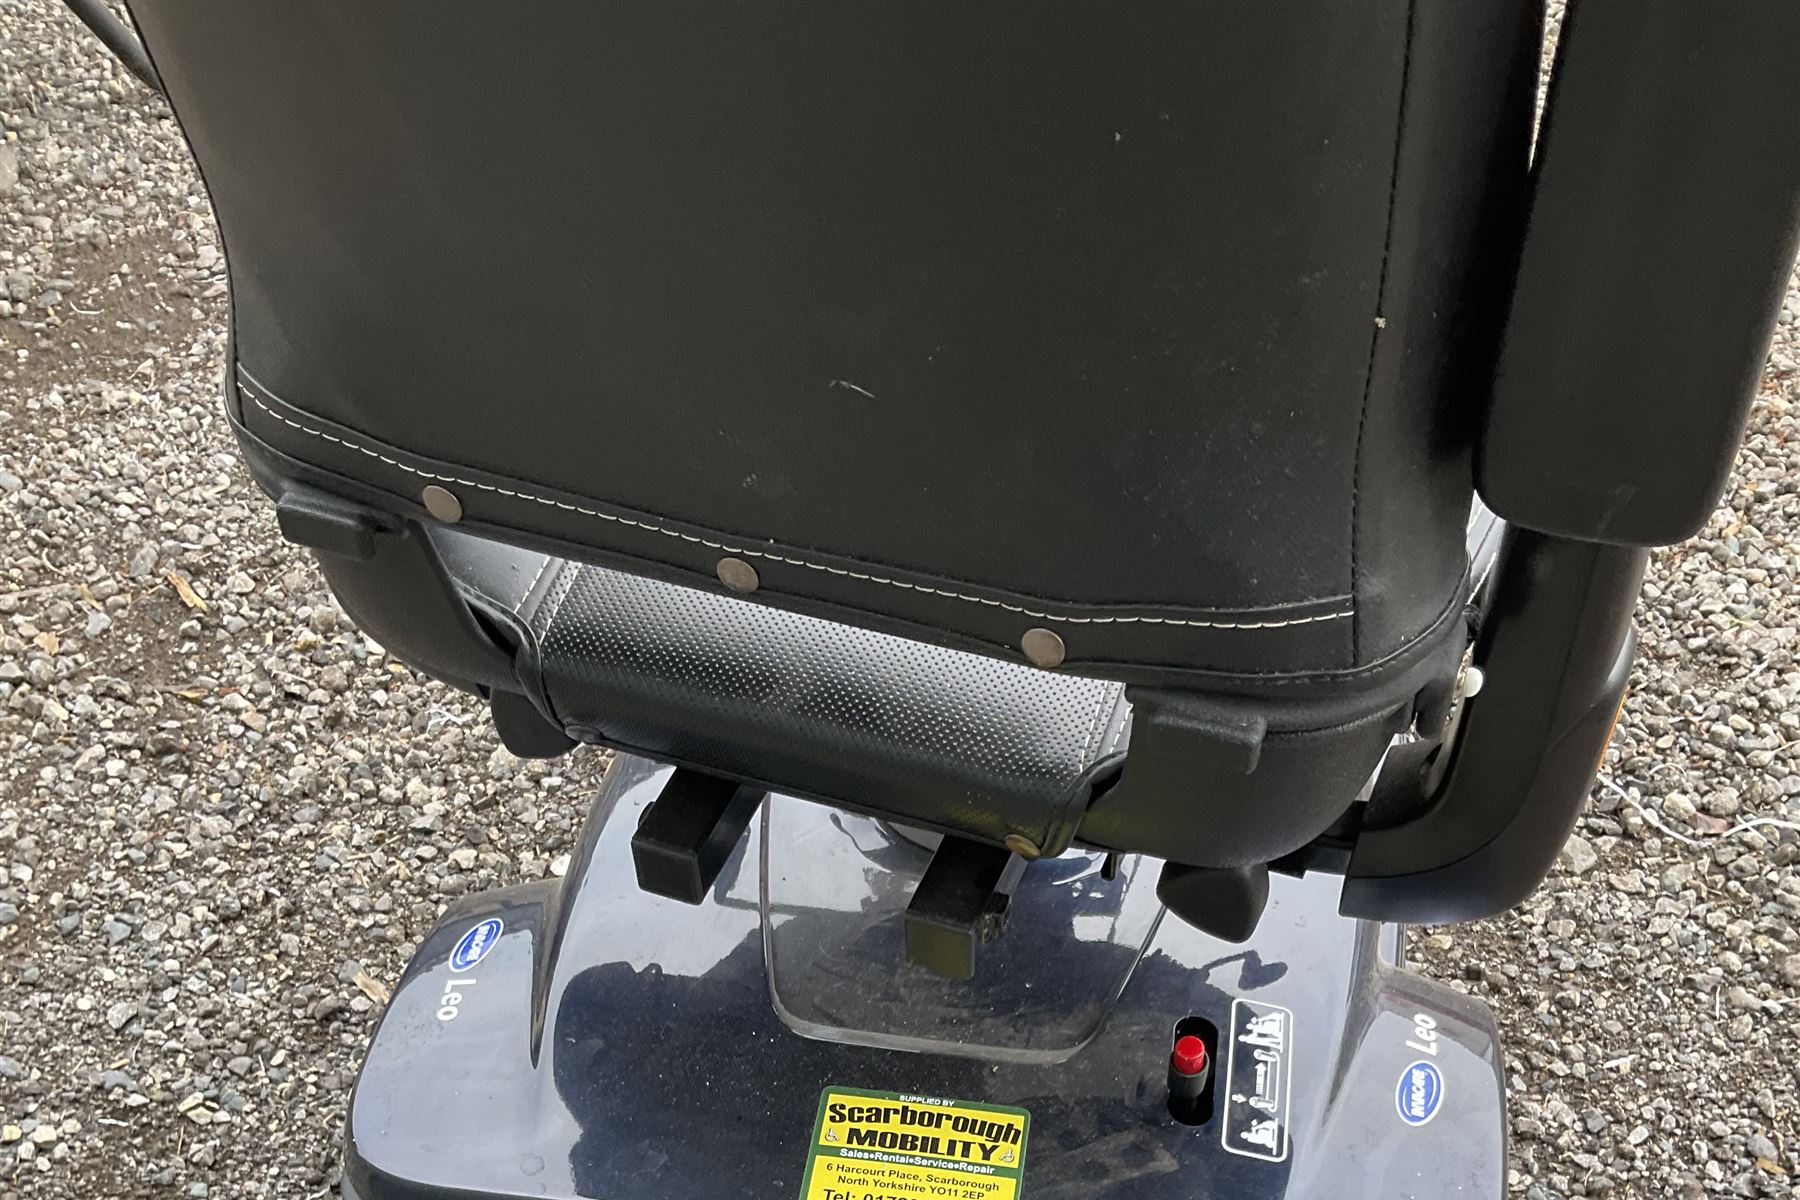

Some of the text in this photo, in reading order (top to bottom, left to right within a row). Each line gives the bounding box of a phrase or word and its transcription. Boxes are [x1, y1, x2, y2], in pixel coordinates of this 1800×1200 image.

[437, 979, 477, 1021] Leo
[1405, 1013, 1438, 1057] Leo
[899, 1095, 955, 1107] SUPPLIED BY
[828, 1103, 1022, 1145] Scarborough
[846, 1127, 1001, 1161] MOBILITY
[826, 1163, 1000, 1191] 6 Harcourt Place, Scarborough
[837, 1175, 985, 1200] North Yorkshire YO11 2EP
